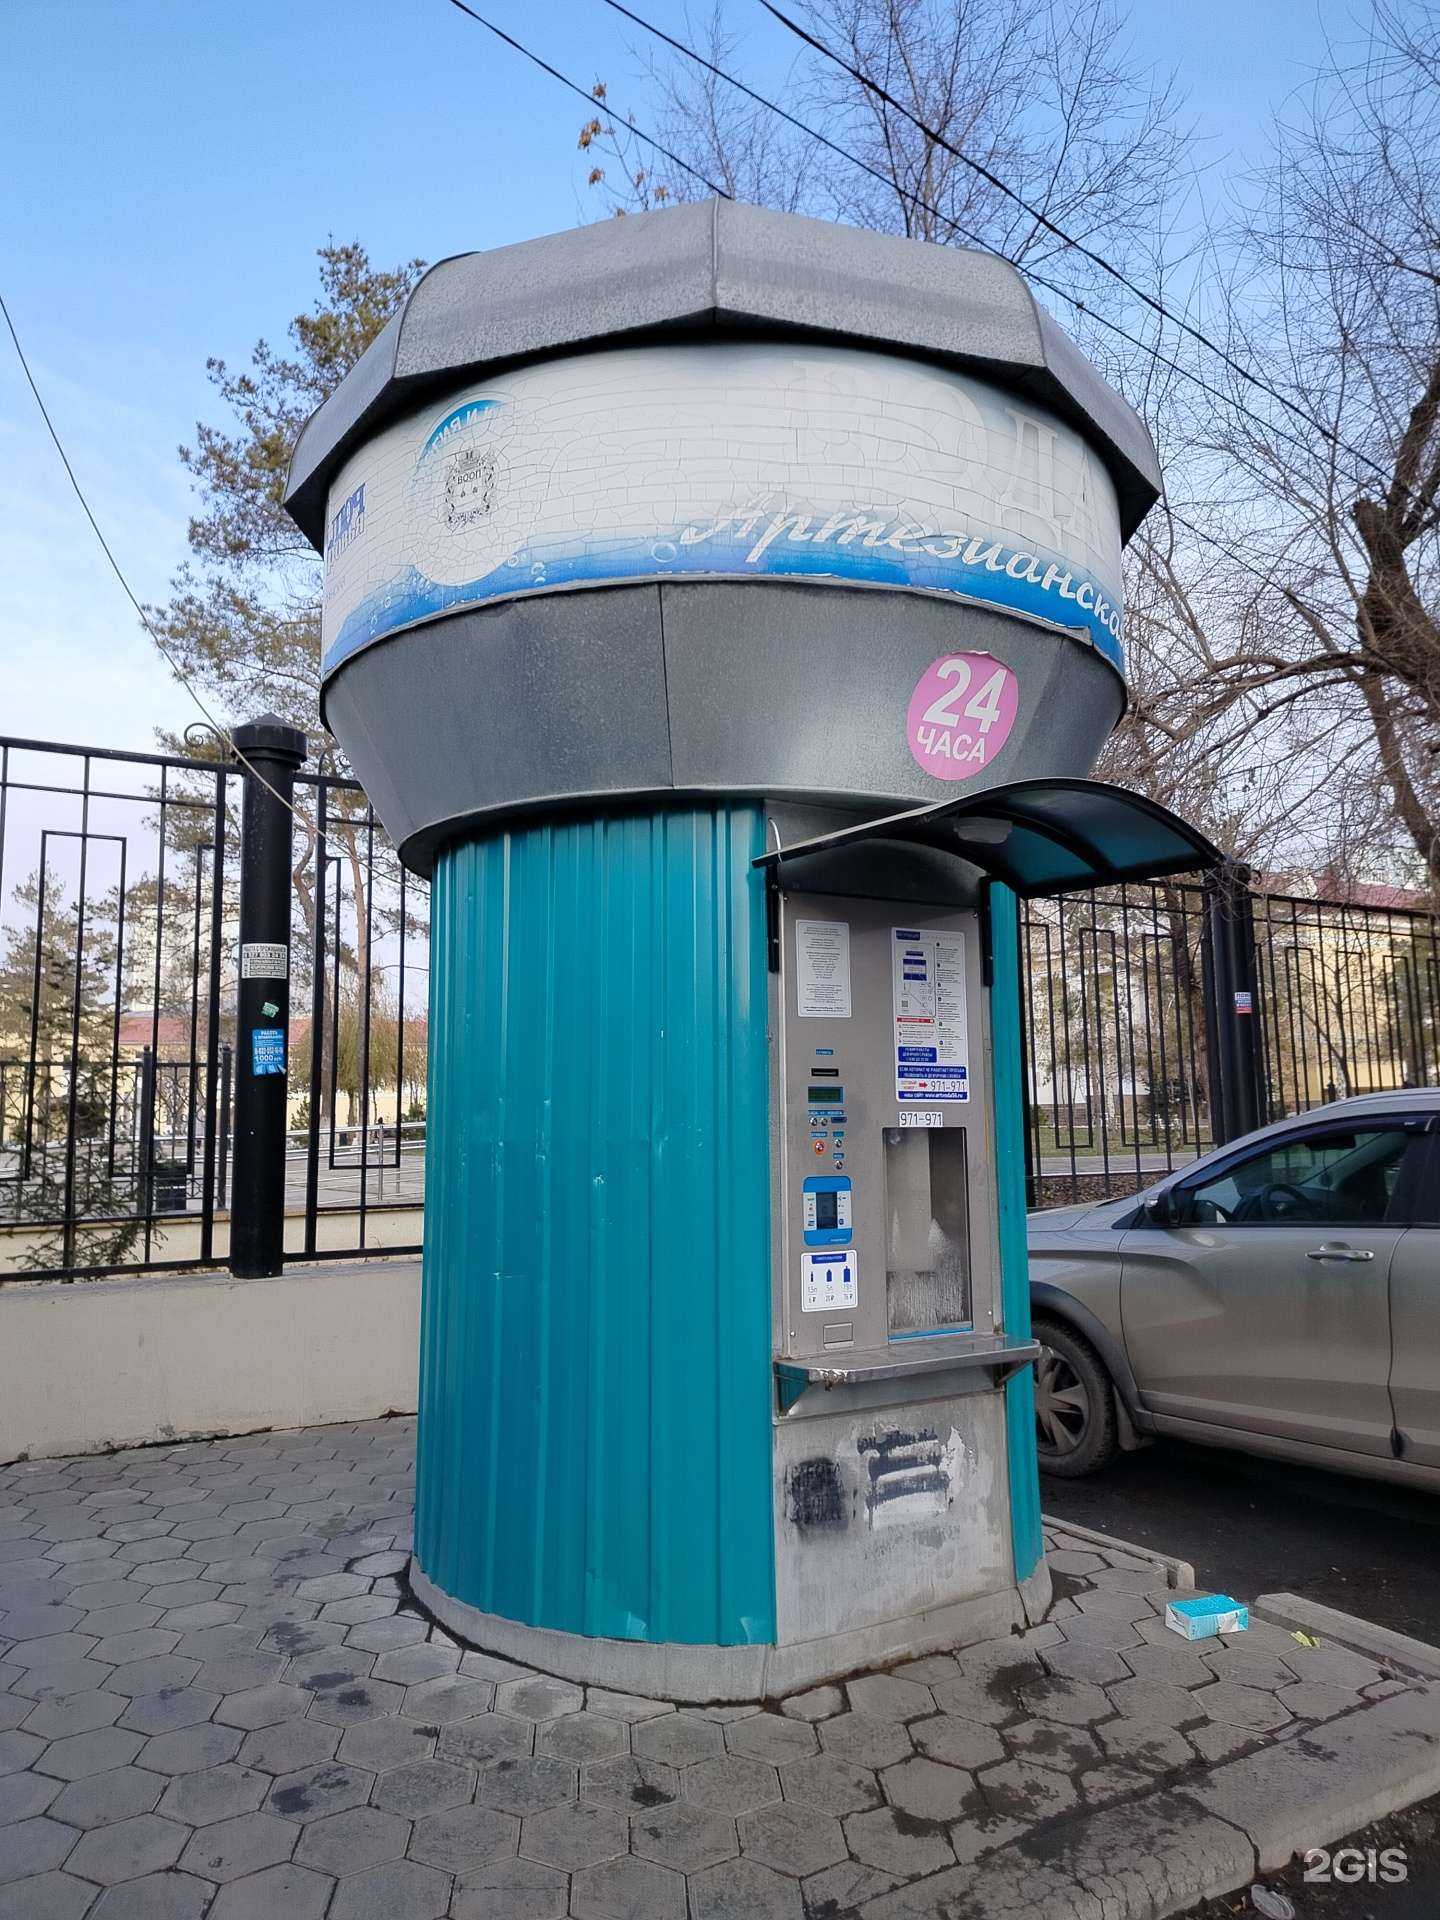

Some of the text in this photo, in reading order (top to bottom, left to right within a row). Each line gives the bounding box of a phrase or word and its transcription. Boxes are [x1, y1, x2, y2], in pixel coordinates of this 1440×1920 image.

[680, 492, 1123, 647] Артезианска
[922, 659, 1007, 733] 24
[917, 725, 985, 763] ЧАСА
[930, 1080, 965, 1092] 971-971
[900, 1112, 942, 1126] 971-971
